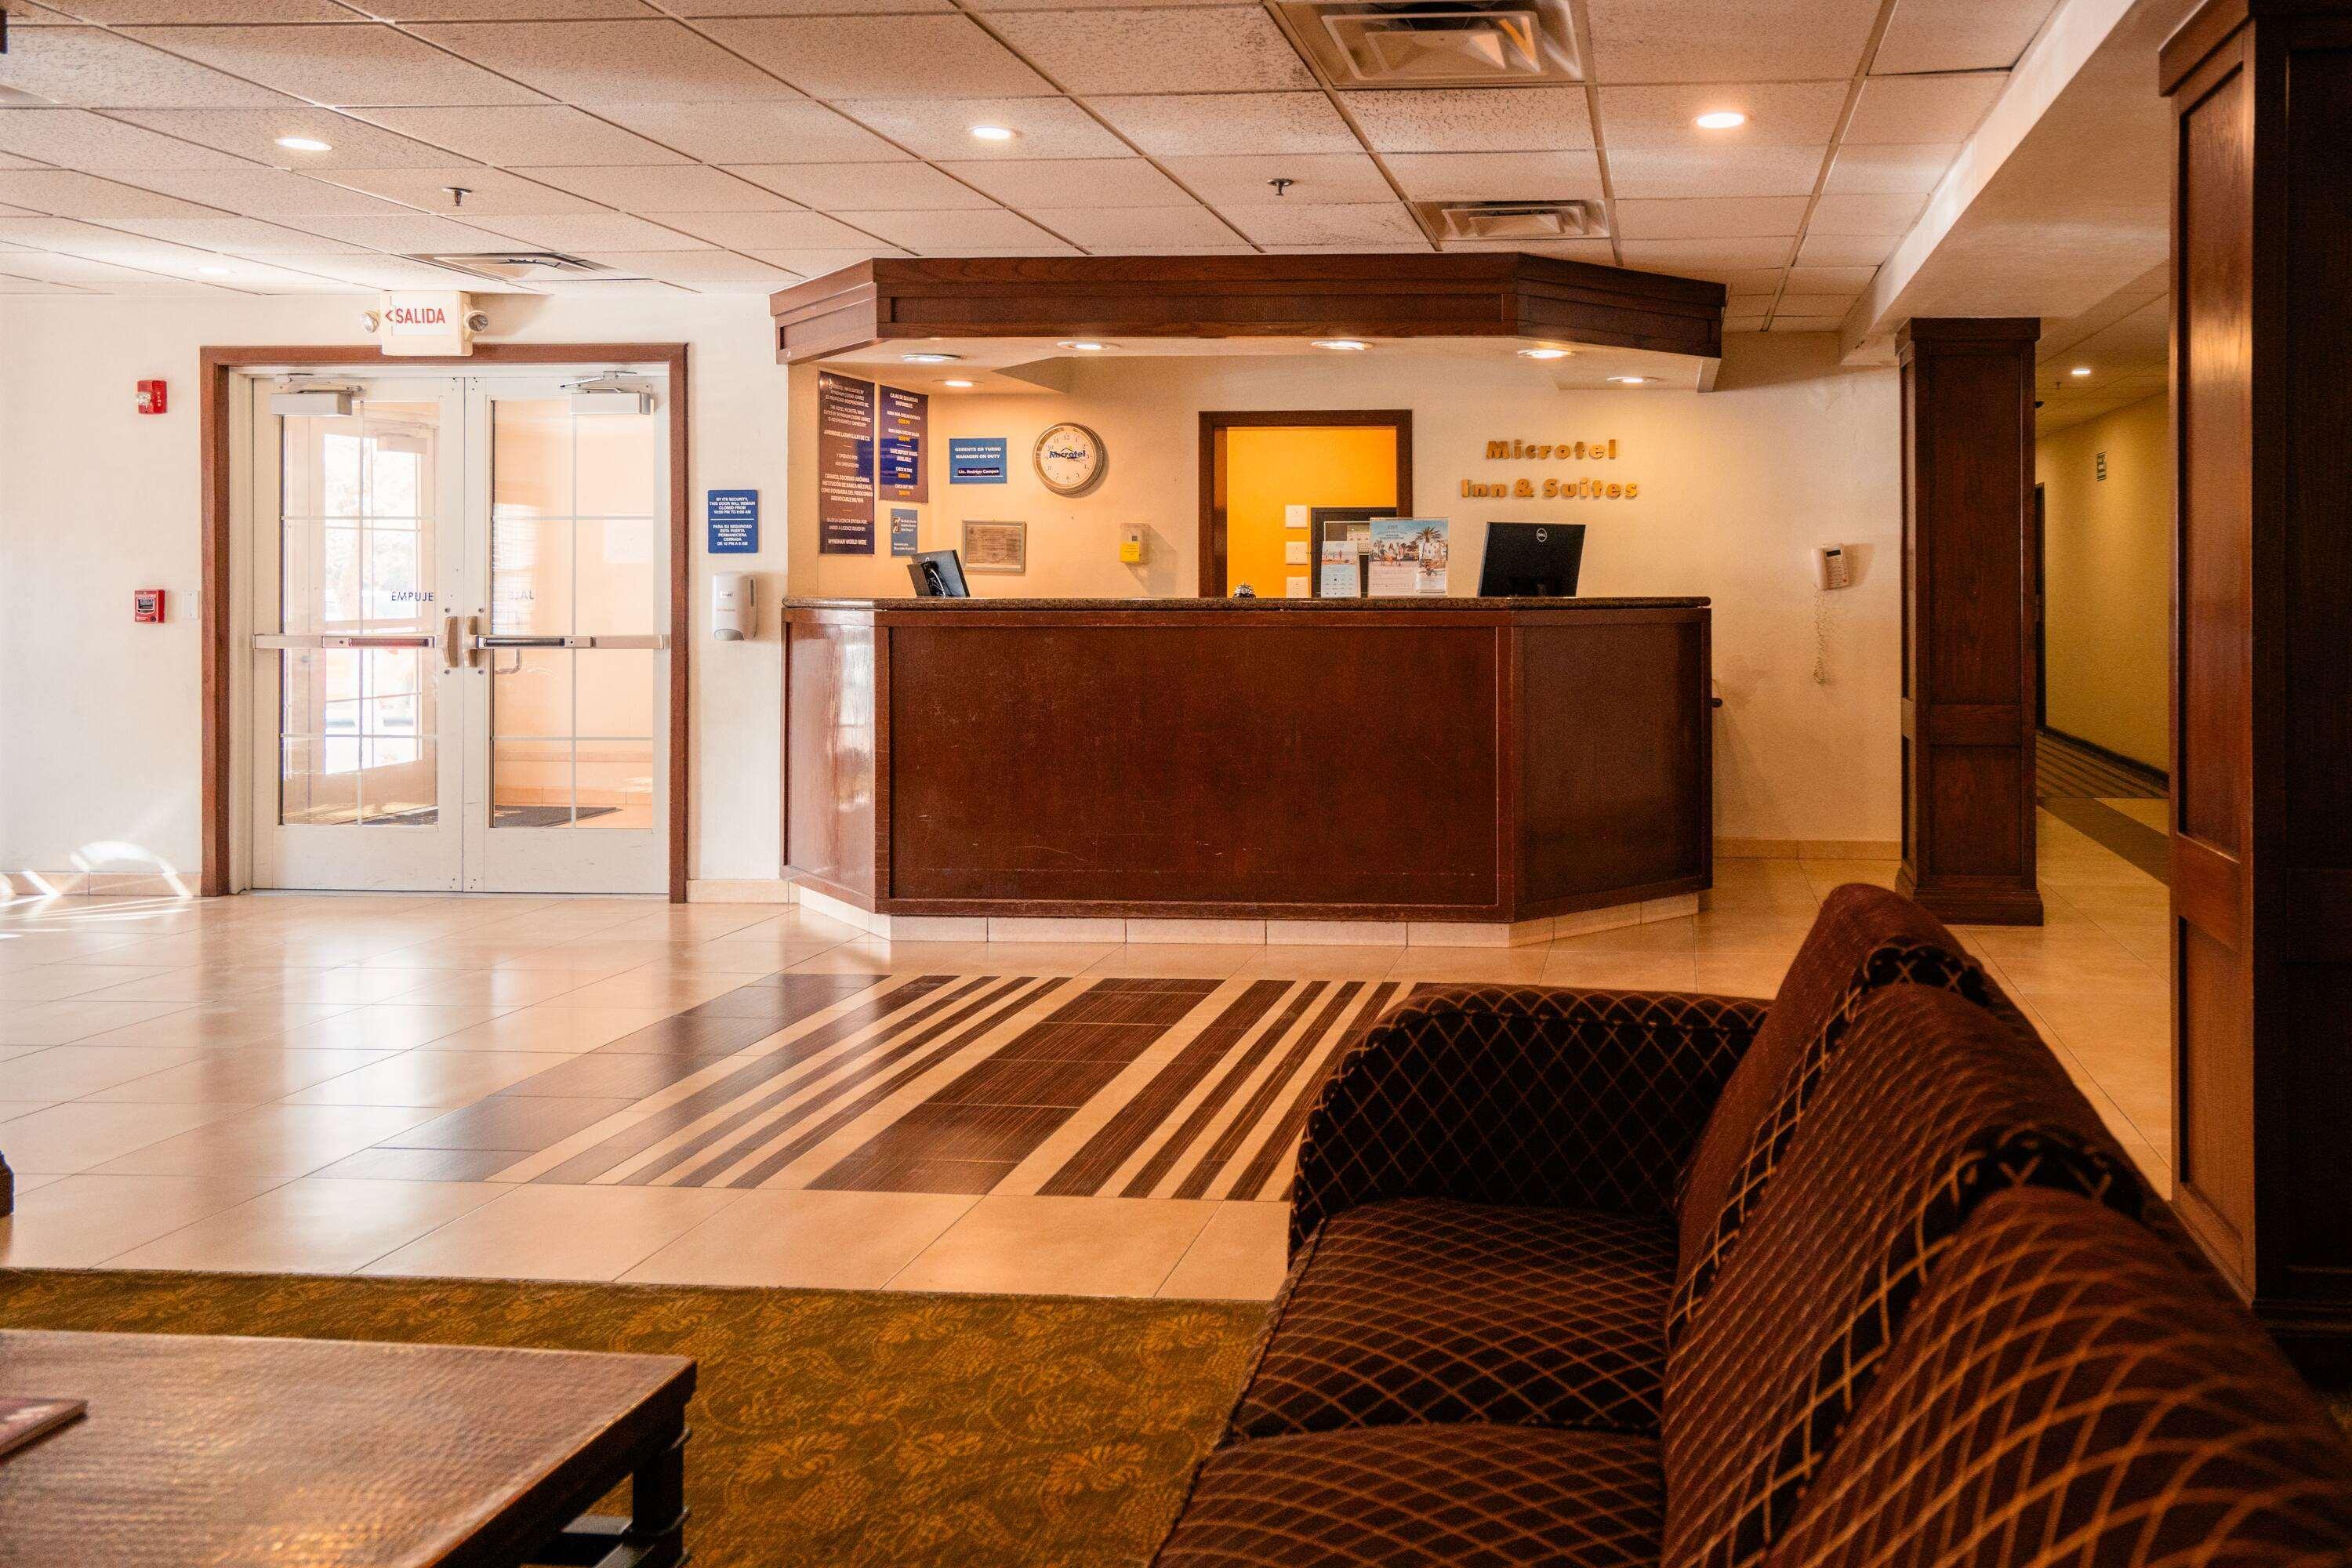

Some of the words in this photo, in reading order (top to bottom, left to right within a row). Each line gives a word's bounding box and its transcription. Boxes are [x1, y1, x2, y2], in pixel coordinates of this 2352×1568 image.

[396, 308, 445, 324] SALIDA
[1486, 439, 1616, 459] Microtel
[1461, 478, 1506, 498] Inn
[1514, 478, 1534, 498] &
[1543, 477, 1639, 499] Suites
[391, 592, 434, 601] EMPUJE
